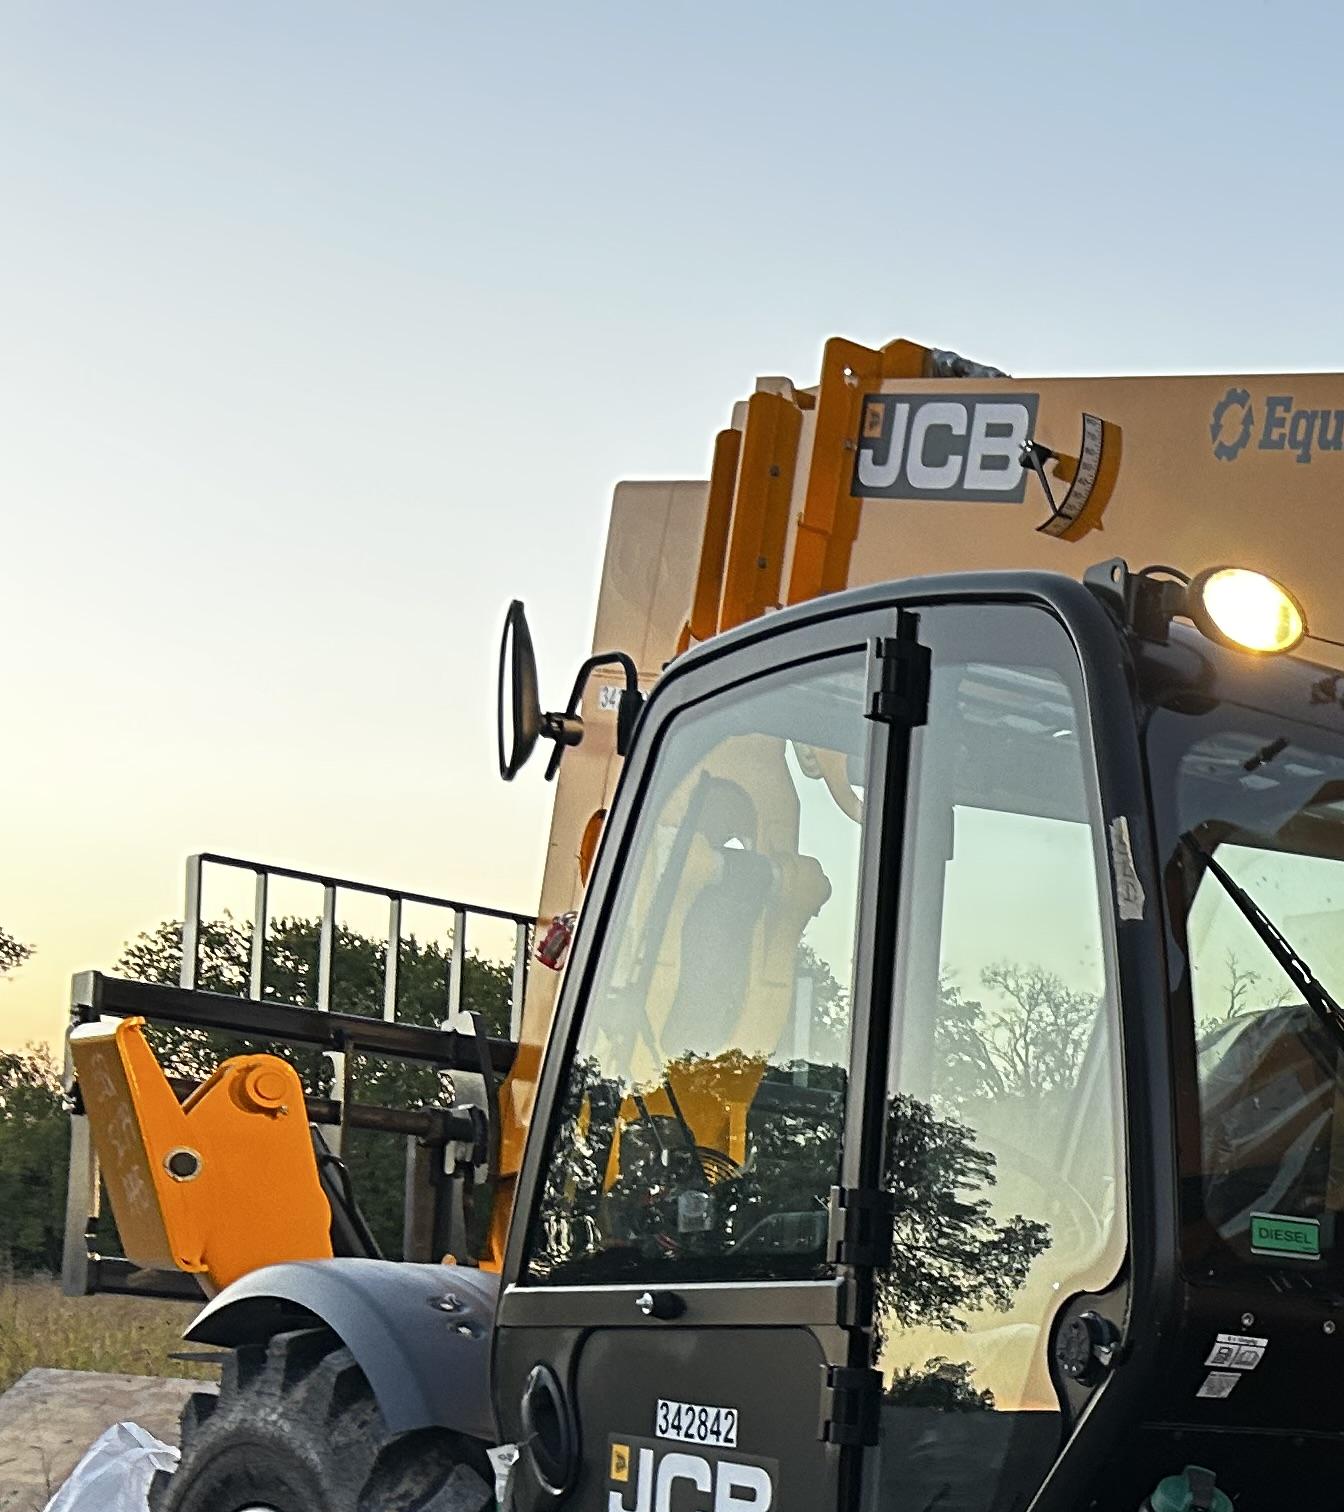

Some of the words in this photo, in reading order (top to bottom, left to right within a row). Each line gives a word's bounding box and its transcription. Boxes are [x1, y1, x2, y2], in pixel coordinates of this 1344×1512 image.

[858, 402, 1030, 491] JCB
[1258, 1227, 1313, 1245] DIESEL
[658, 1402, 736, 1444] 342842
